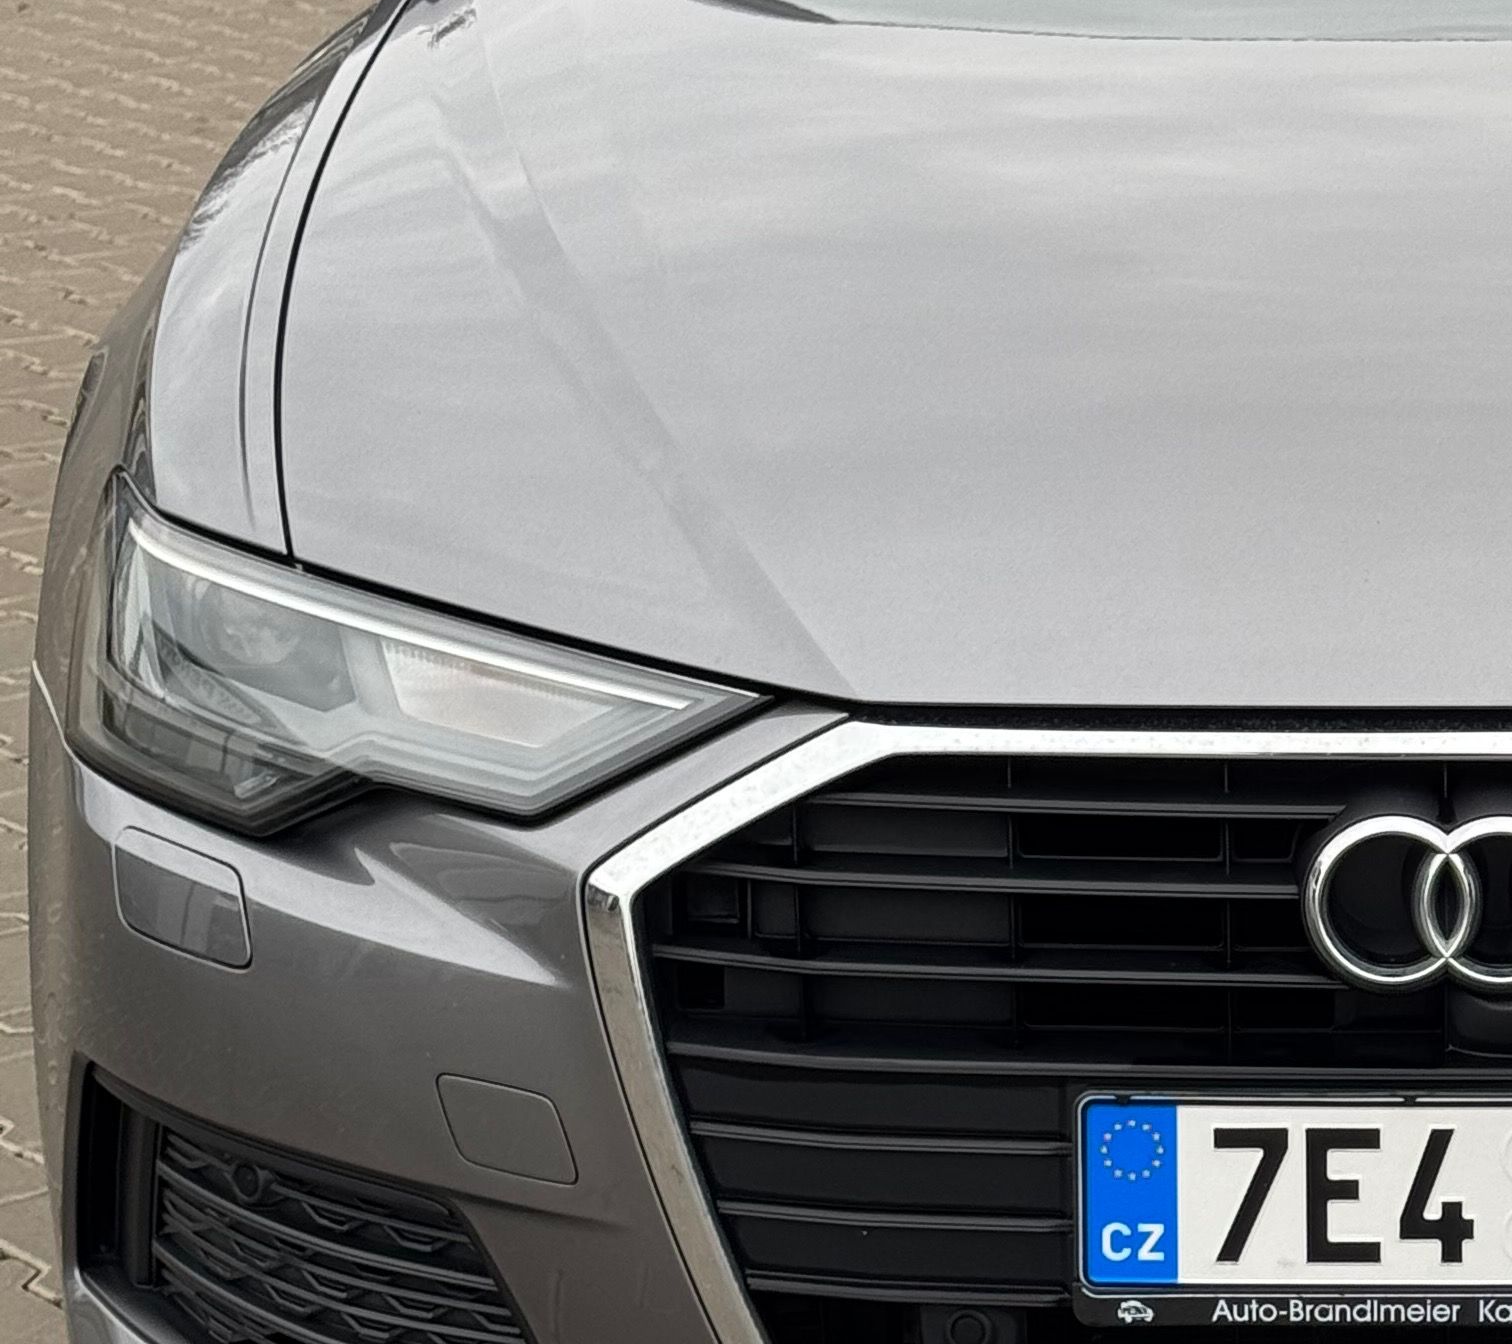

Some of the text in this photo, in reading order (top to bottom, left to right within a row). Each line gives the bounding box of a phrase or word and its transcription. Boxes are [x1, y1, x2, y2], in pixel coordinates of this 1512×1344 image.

[1214, 1128, 1474, 1263] 7E4
[1103, 1223, 1164, 1260] CZ
[1213, 1300, 1460, 1322] Auto-Brandlmeier
